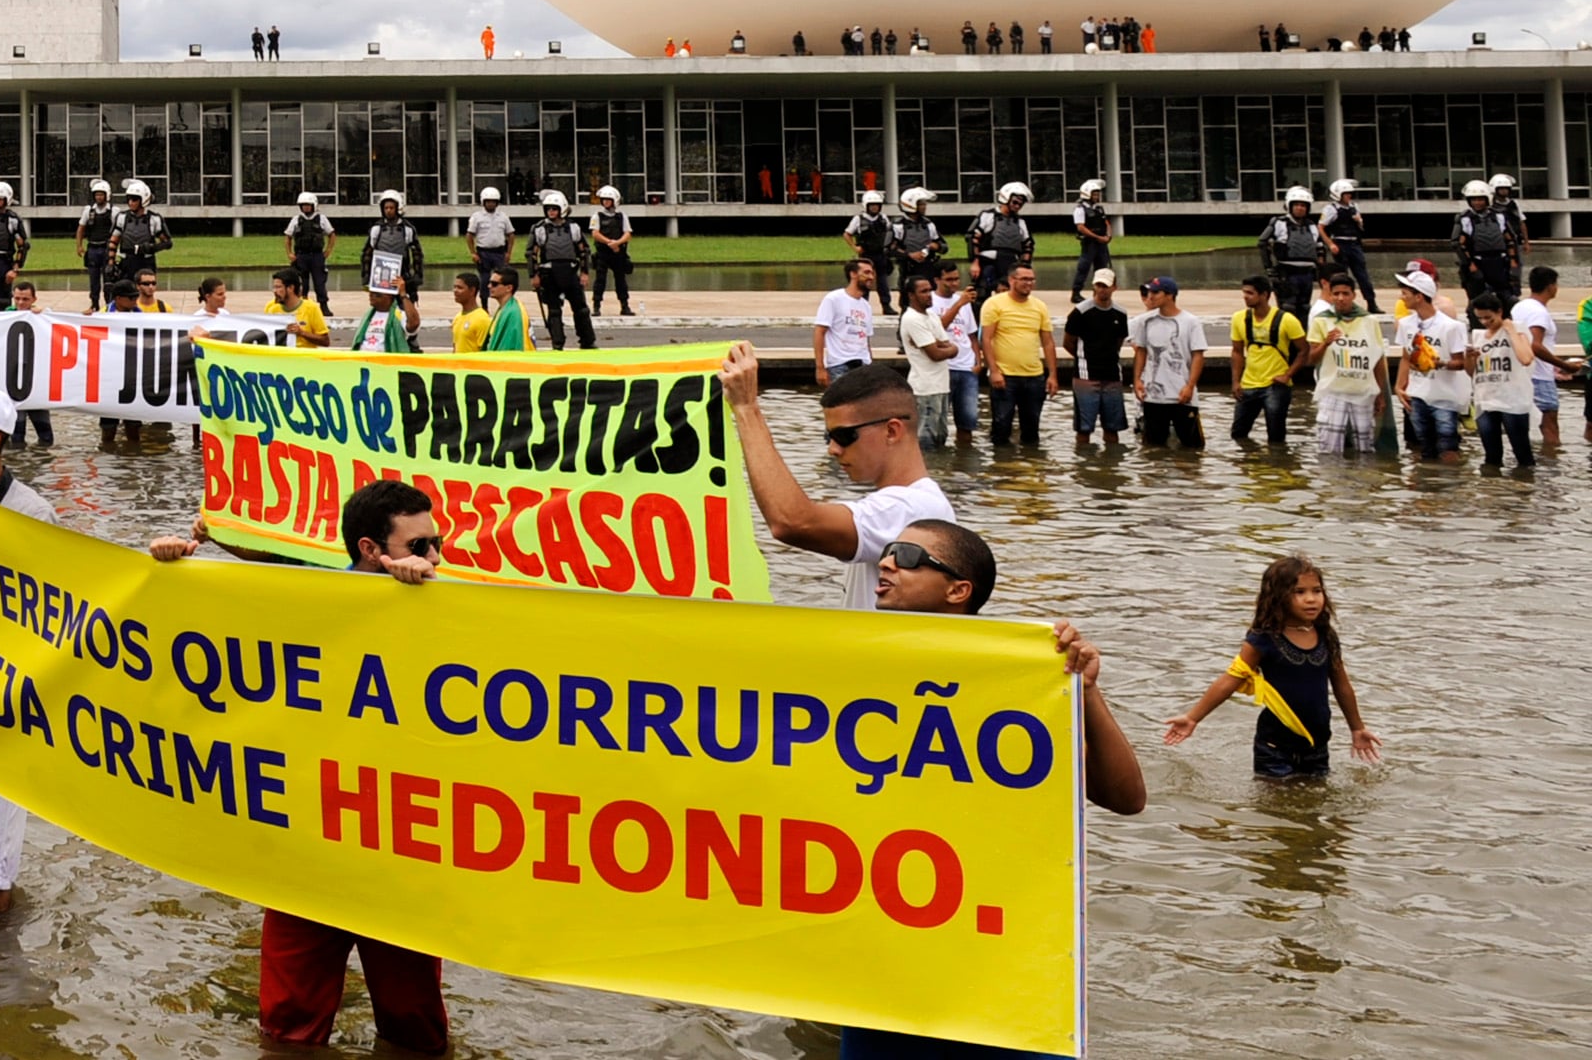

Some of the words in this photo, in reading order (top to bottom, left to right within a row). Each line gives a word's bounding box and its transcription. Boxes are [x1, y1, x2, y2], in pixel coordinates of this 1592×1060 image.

[6, 320, 35, 402] O
[48, 323, 110, 403] PT
[202, 430, 340, 543] BASTA
[351, 368, 397, 453] de
[398, 371, 727, 488] PARASITAS!
[171, 630, 323, 713] QUE
[347, 653, 400, 726] A
[424, 663, 1055, 795] CORRUPÇÃO
[67, 693, 290, 829] CRIME
[319, 758, 1003, 936] HEDIONDO.
